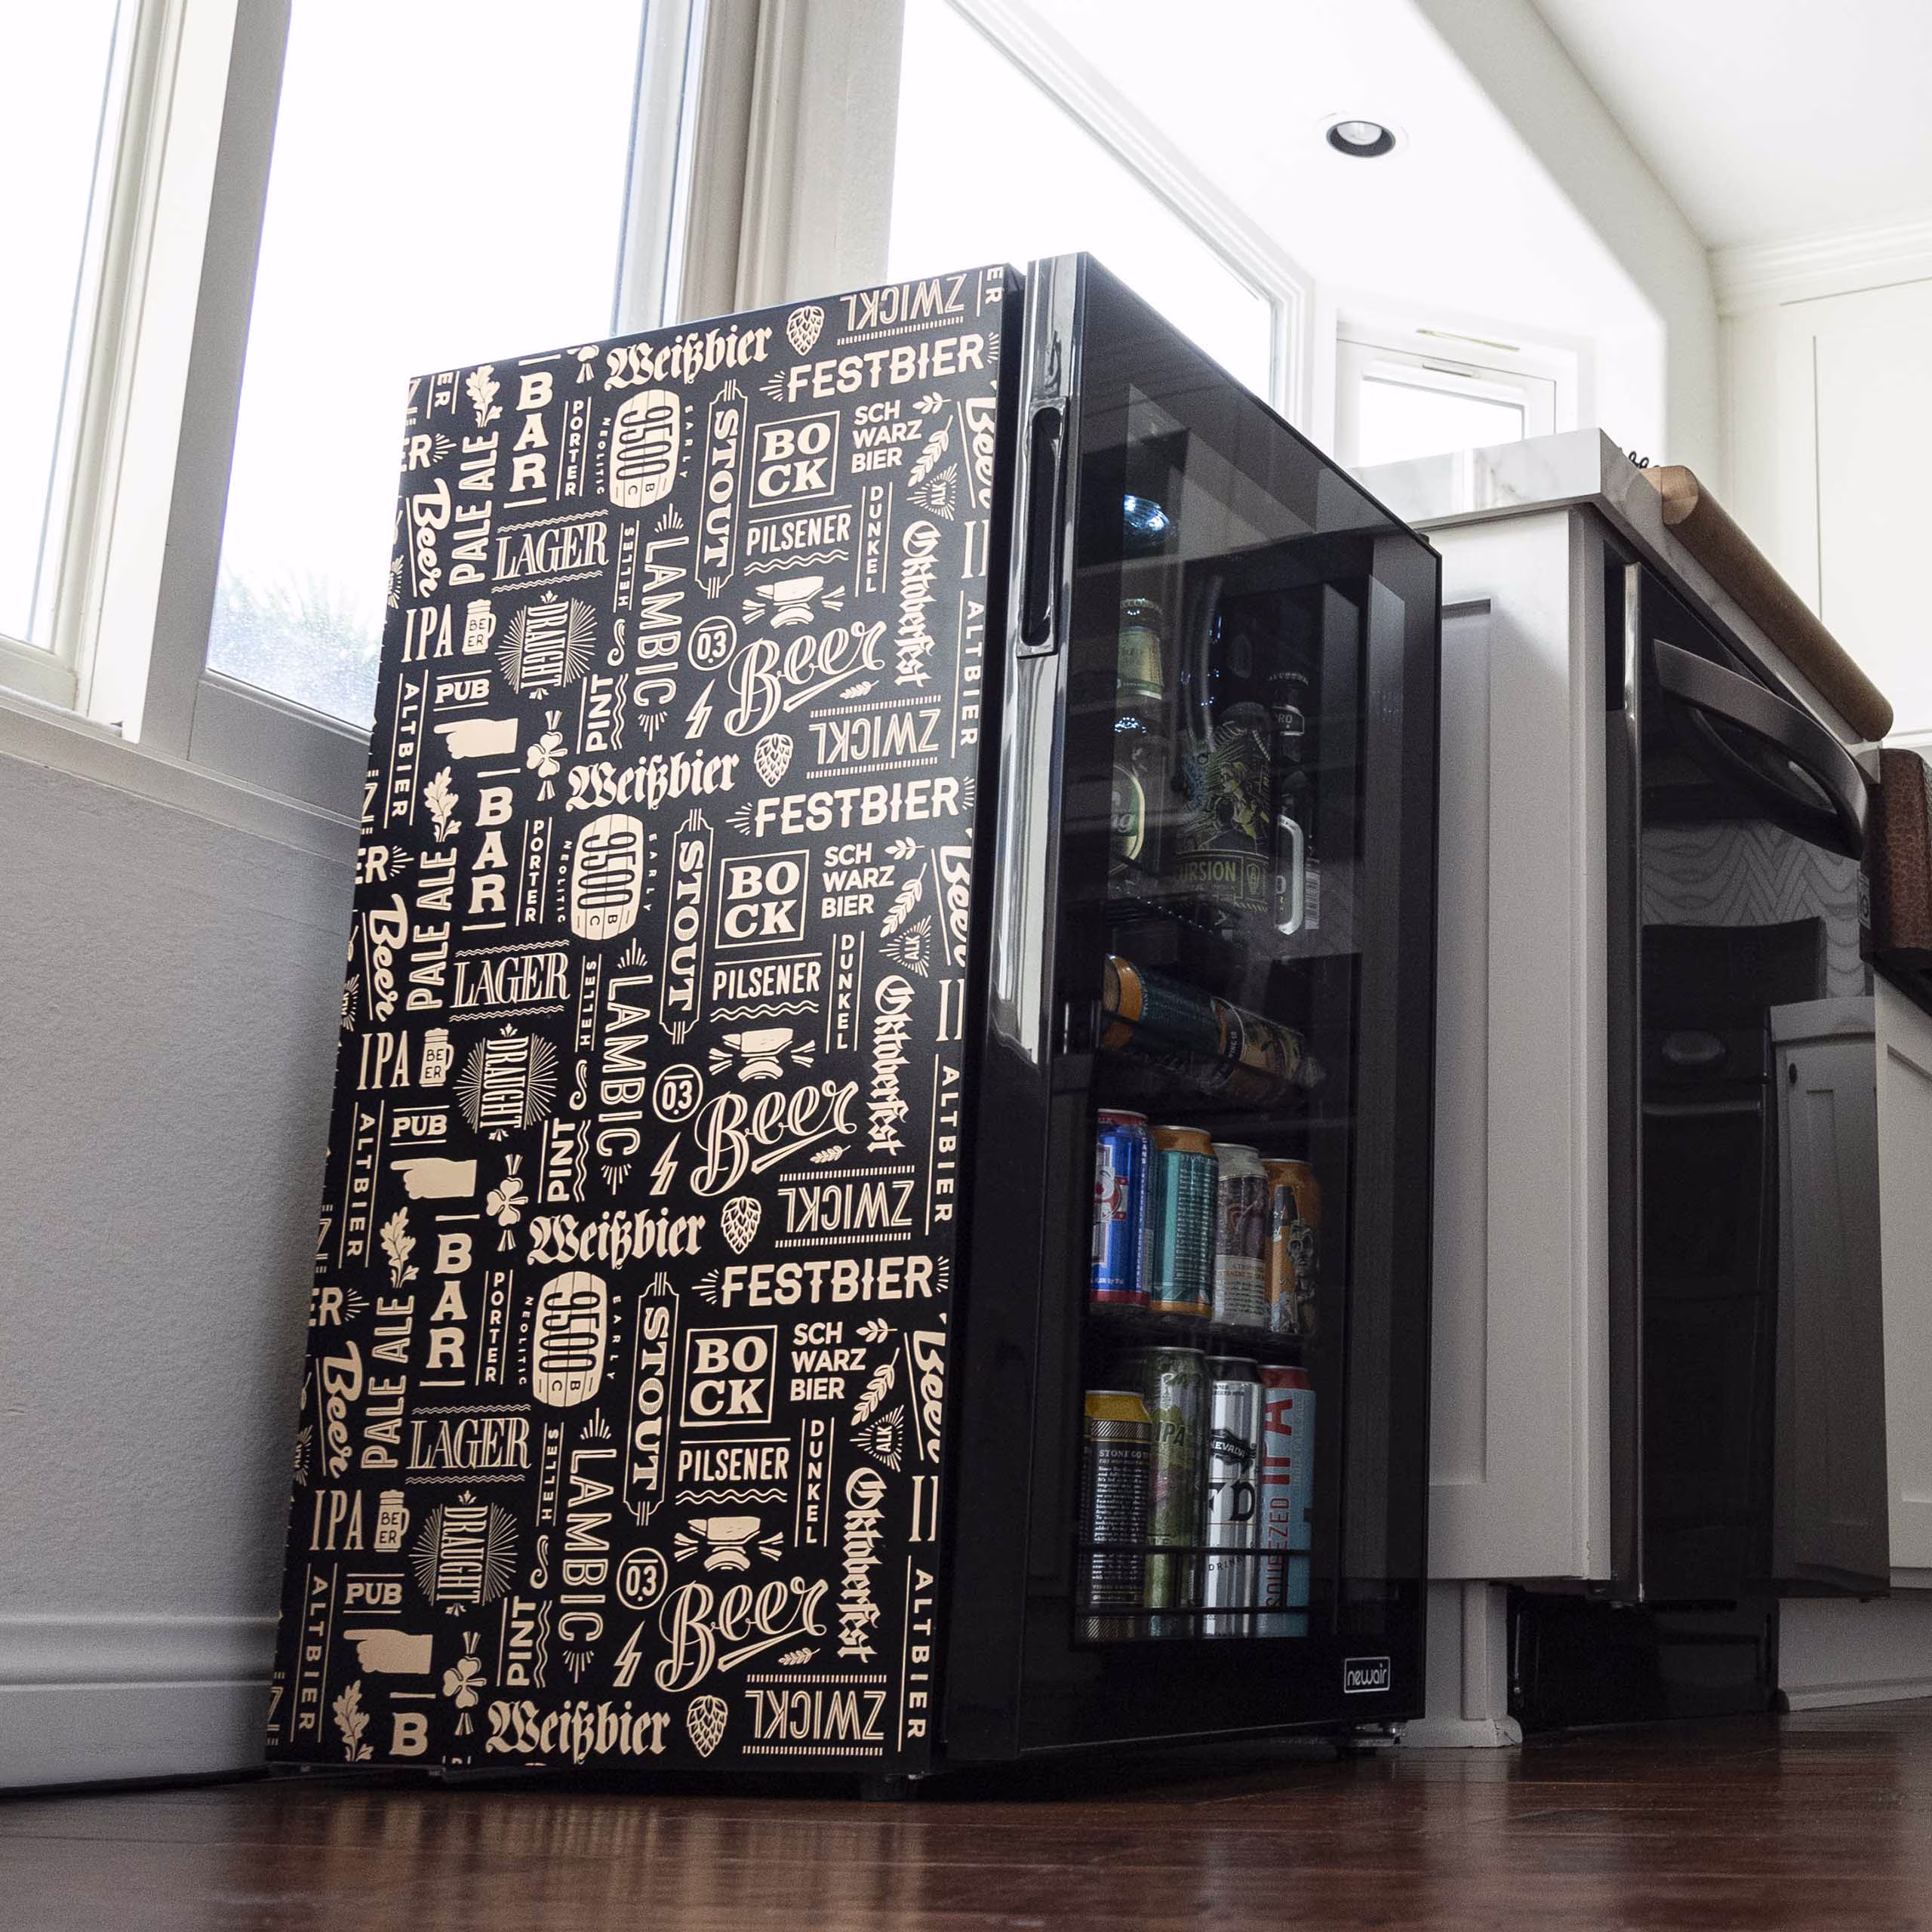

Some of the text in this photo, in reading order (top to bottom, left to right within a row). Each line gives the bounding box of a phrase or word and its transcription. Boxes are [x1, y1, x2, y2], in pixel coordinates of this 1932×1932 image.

[840, 273, 967, 331] ZWICKL
[787, 334, 986, 402] FESTBIER
[509, 372, 552, 492] BAR
[565, 401, 583, 496] PORTER
[680, 405, 694, 477] EARLY
[851, 447, 902, 473] BIER
[853, 420, 922, 449] WARZ
[449, 431, 499, 586] PALE ALE
[704, 409, 739, 567] STOUT
[413, 478, 451, 598] Beer
[492, 521, 609, 580] LAGER
[618, 528, 635, 606] HELLES
[746, 513, 851, 555] PILSENER
[866, 486, 883, 592] DUNKEL
[401, 604, 453, 663] IPA
[521, 601, 568, 688] DRAUGHT
[634, 537, 689, 706] LAMBIC
[435, 679, 489, 703] PUB
[586, 674, 613, 752] PINT
[724, 621, 887, 736] Beer
[960, 600, 985, 746] ALTBIER
[392, 683, 420, 817] ALTBIER
[809, 709, 940, 764] ZWICKL
[469, 787, 512, 913] BAR
[755, 777, 963, 837] FESTBIER
[525, 820, 544, 921] PORTER
[644, 834, 657, 910] EARLY
[822, 894, 874, 918] BIER
[823, 866, 895, 892] WARZ
[370, 894, 408, 1022] Beer
[406, 848, 457, 1011] PALE ALE
[669, 841, 704, 1011] STOUT
[450, 952, 571, 1008] LAGER
[580, 961, 596, 1045] HELLES
[713, 961, 820, 1001] PILSENER
[838, 934, 854, 1049] DUNKEL
[357, 1031, 410, 1090] IPA
[480, 1037, 528, 1128] DRAUGHT
[597, 975, 653, 1156] LAMBIC
[392, 1115, 447, 1137] PUB
[547, 1118, 575, 1201] PINT
[691, 1080, 858, 1196] Beer
[935, 1066, 959, 1222] ALTBIER
[347, 1113, 375, 1256] ALTBIER
[778, 1180, 914, 1232] ZWICKL
[426, 1233, 472, 1367] BAR
[721, 1256, 932, 1307] FESTBIER
[485, 1272, 504, 1381] PORTER
[608, 1296, 621, 1379] EARLY
[792, 1349, 866, 1373] WARZ
[323, 1341, 362, 1478] Beer
[361, 1296, 414, 1468] PALE ALE
[633, 1307, 669, 1490] STOUT
[791, 1377, 844, 1401] BIER
[407, 1418, 531, 1469] LAGER
[542, 1429, 558, 1519] HELLES
[678, 1447, 789, 1481] PILSENER
[807, 1420, 824, 1543] DUNKEL
[309, 1490, 364, 1550] IPA
[436, 1506, 488, 1603] DRAUGHT
[558, 1449, 617, 1641] LAMBIC
[345, 1583, 401, 1604] PUB
[655, 1577, 828, 1692] Beer
[299, 1576, 328, 1729] ALTBIER
[507, 1596, 536, 1685] PINT
[908, 1569, 933, 1737] ALTBIER
[1347, 1663, 1387, 1687] newair
[746, 1690, 886, 1740] ZWICKL
